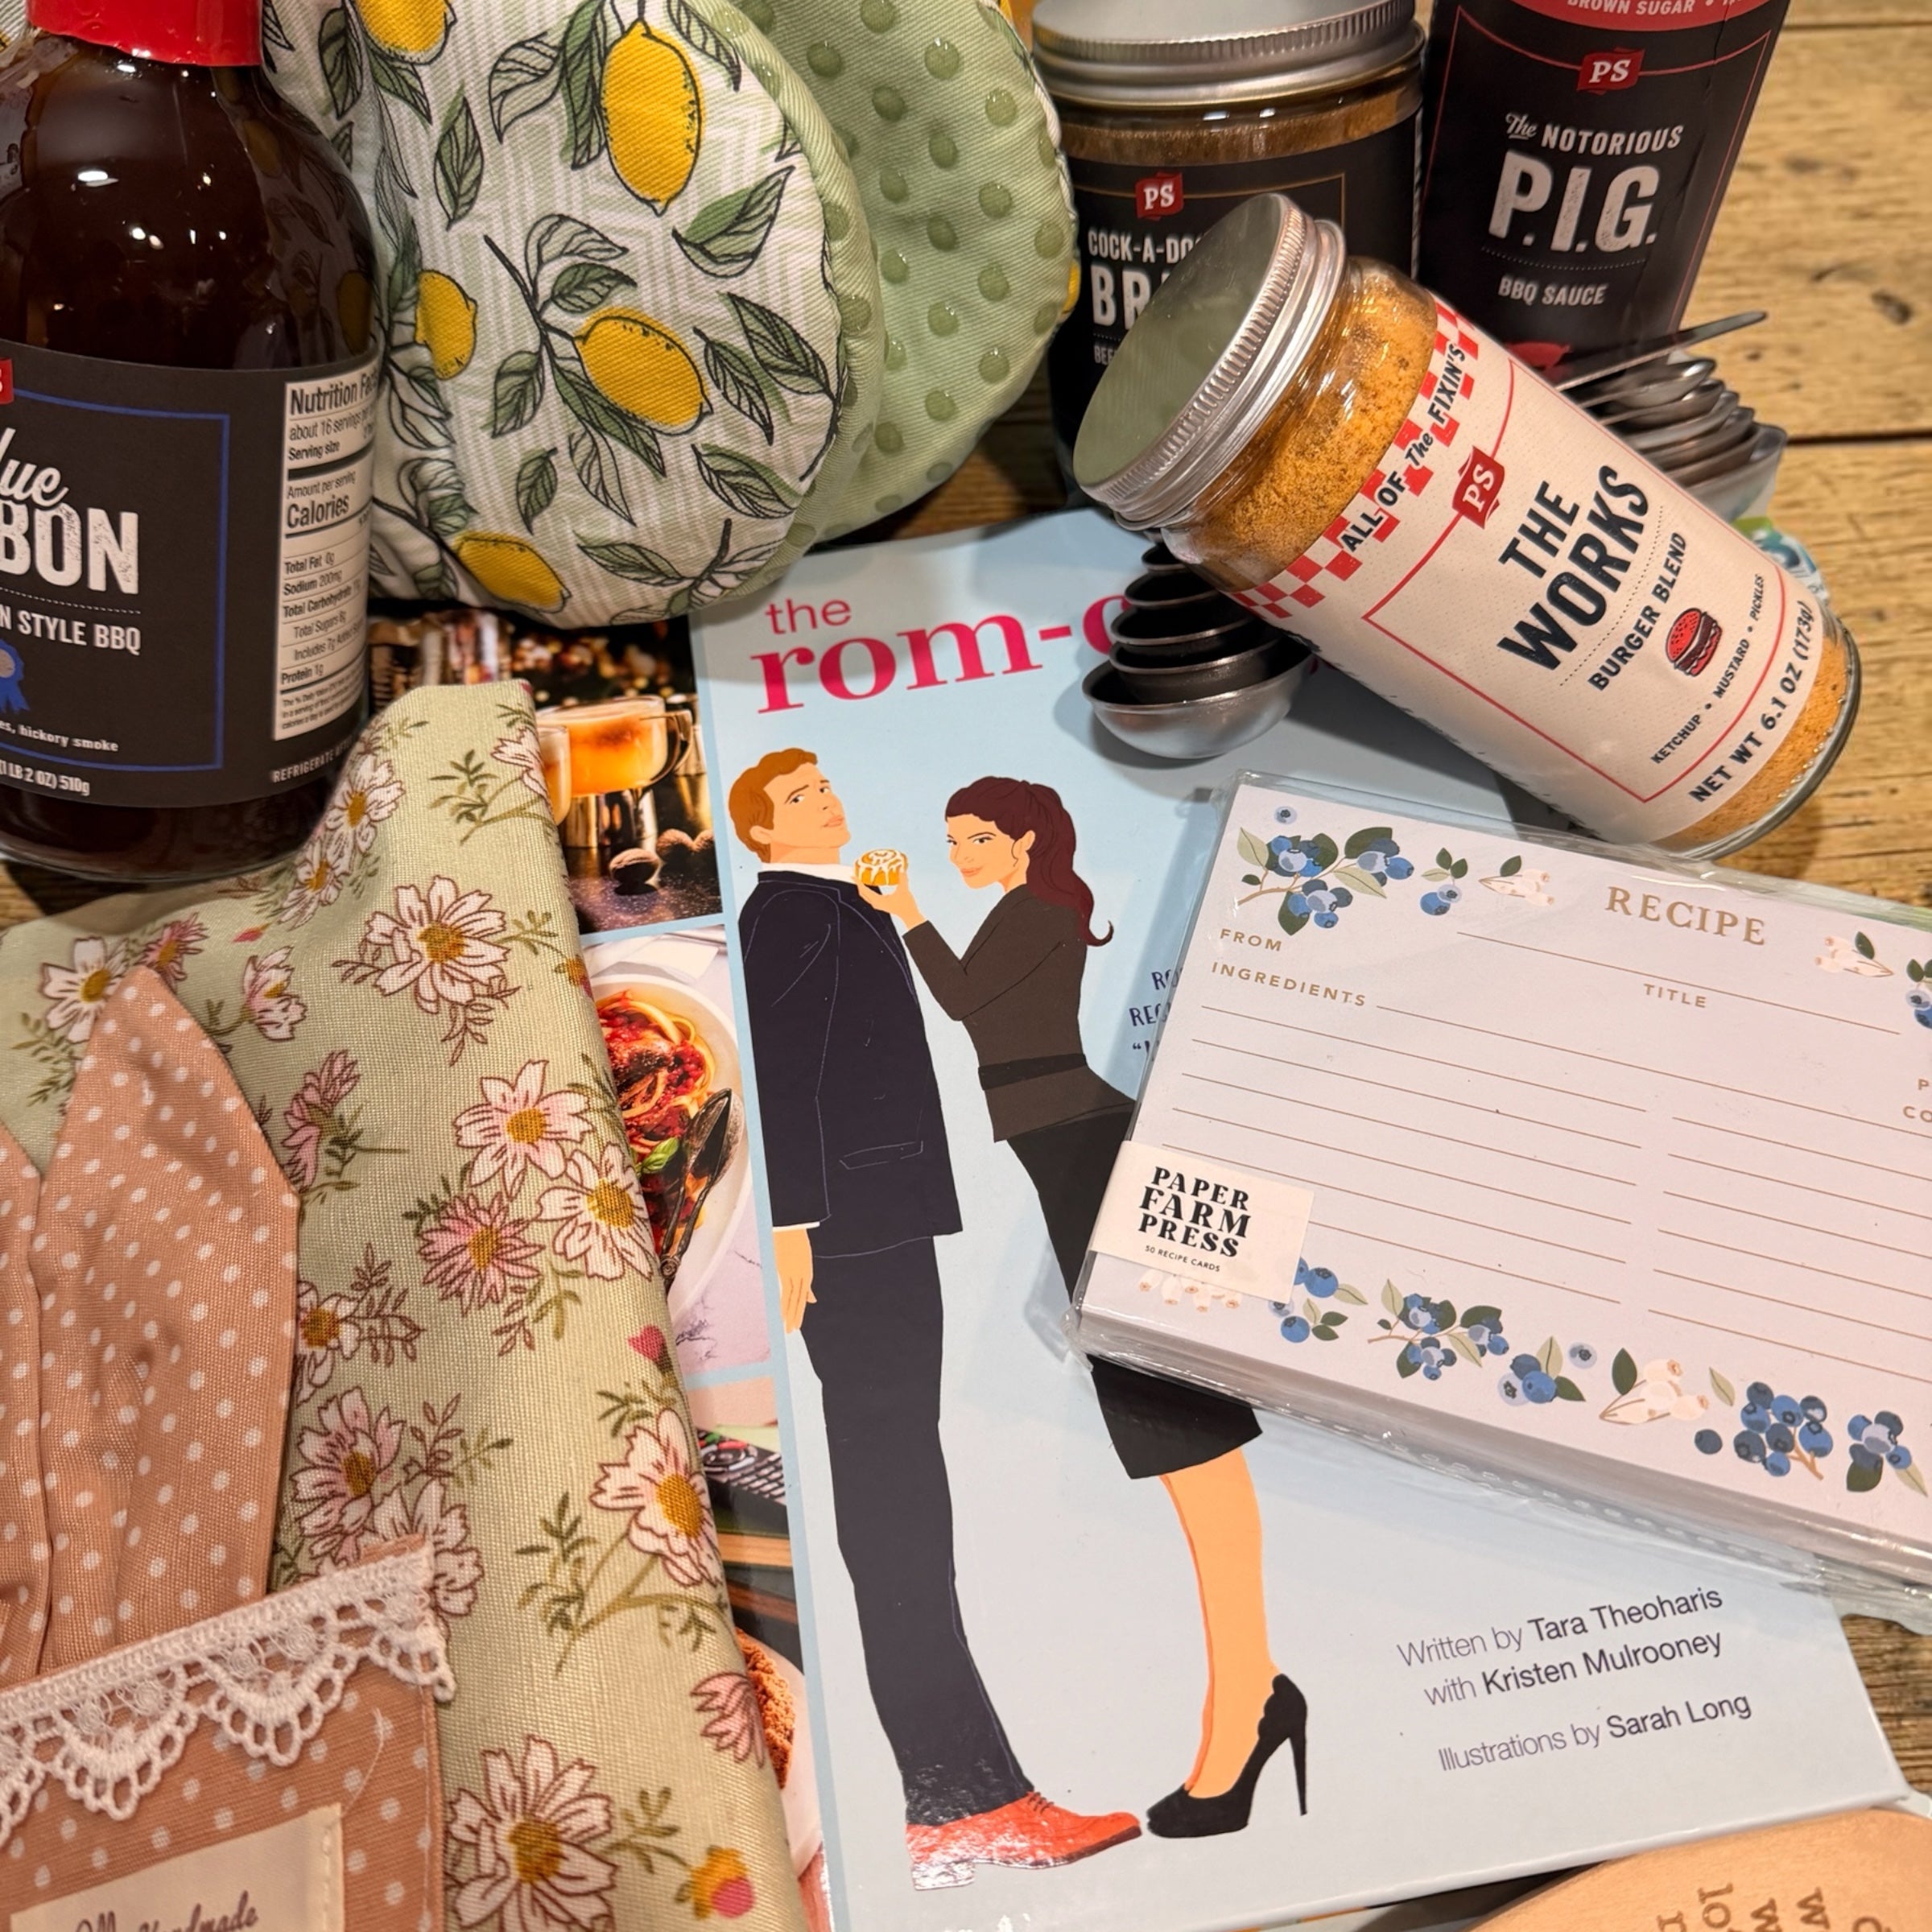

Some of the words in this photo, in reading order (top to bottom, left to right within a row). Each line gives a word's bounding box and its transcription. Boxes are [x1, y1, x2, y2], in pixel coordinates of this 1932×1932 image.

[1636, 0, 1694, 15] SUGAR
[1588, 60, 1631, 84] PS
[1505, 112, 1537, 139] The
[1541, 124, 1684, 155] NOTORIOUS
[1143, 184, 1175, 210] PS
[1489, 150, 1661, 253] P.I.G.
[1090, 263, 1170, 330] BR
[1498, 275, 1537, 305] BBQ
[1542, 284, 1608, 307] SAUCE
[290, 382, 358, 416] Nutrition
[289, 422, 319, 441] about
[321, 418, 332, 436] 16
[288, 444, 323, 460] Serving
[324, 440, 341, 455] size
[1340, 512, 1384, 552] ALL
[1377, 470, 1406, 506] OF
[1404, 432, 1434, 466] The
[1427, 343, 1466, 425] FIXIN'S
[287, 481, 322, 499] Amount
[322, 480, 335, 494] per
[335, 471, 356, 488] serving
[1462, 464, 1494, 513] PS
[287, 494, 349, 529] Calories
[1498, 481, 1580, 579] THE
[284, 558, 308, 575] Total
[309, 555, 322, 570] Fat
[1496, 465, 1649, 671] WORKS
[283, 580, 317, 596] Sodium
[283, 602, 305, 618] Total
[765, 598, 852, 635] the
[1587, 605, 1661, 691] BURGER
[1652, 532, 1686, 604] BLEND
[19, 610, 87, 646] STYLE
[93, 623, 141, 655] BBQ
[293, 622, 314, 639] Total
[293, 642, 326, 661] Includes
[1650, 713, 1702, 764] KETCHUP
[1712, 638, 1750, 699] MUSTARD
[1751, 573, 1765, 621] PICKLES
[280, 667, 313, 685] Protein
[1688, 765, 1733, 803] NET
[1730, 731, 1763, 766] WT
[1760, 696, 1787, 731] 6.1
[1780, 663, 1803, 696] OZ
[1793, 600, 1814, 662] (173g)
[18, 724, 69, 748] hickory
[72, 737, 119, 752] smoke
[8, 762, 23, 779] LB
[24, 766, 34, 783] 2
[35, 770, 57, 790] OZ)
[59, 775, 90, 796] 510g
[272, 749, 334, 783] REFRIGERATE
[1604, 886, 1765, 945] RECIPE
[1220, 928, 1282, 952] FROM
[1211, 961, 1366, 1006] INGREDIENTS
[1643, 983, 1707, 1009] TITLE
[1151, 1166, 1249, 1211] PAPER
[1139, 1186, 1251, 1238] FARM
[1137, 1212, 1240, 1257] PRESS
[1145, 1245, 1156, 1254] 50
[1158, 1249, 1187, 1264] RECIPE
[1191, 1258, 1220, 1273] CARDS
[1397, 1634, 1488, 1666] Written
[1491, 1627, 1522, 1653] by
[1527, 1617, 1588, 1641] Tara
[1590, 1587, 1723, 1629] Theoharis
[1424, 1676, 1477, 1706] with
[1481, 1661, 1577, 1695] Kristen
[1582, 1632, 1721, 1675] Mulrooney
[1439, 1731, 1567, 1771] Illustrations
[1571, 1724, 1600, 1748] by
[1606, 1706, 1682, 1738] Sarah
[1685, 1695, 1752, 1719] Long
